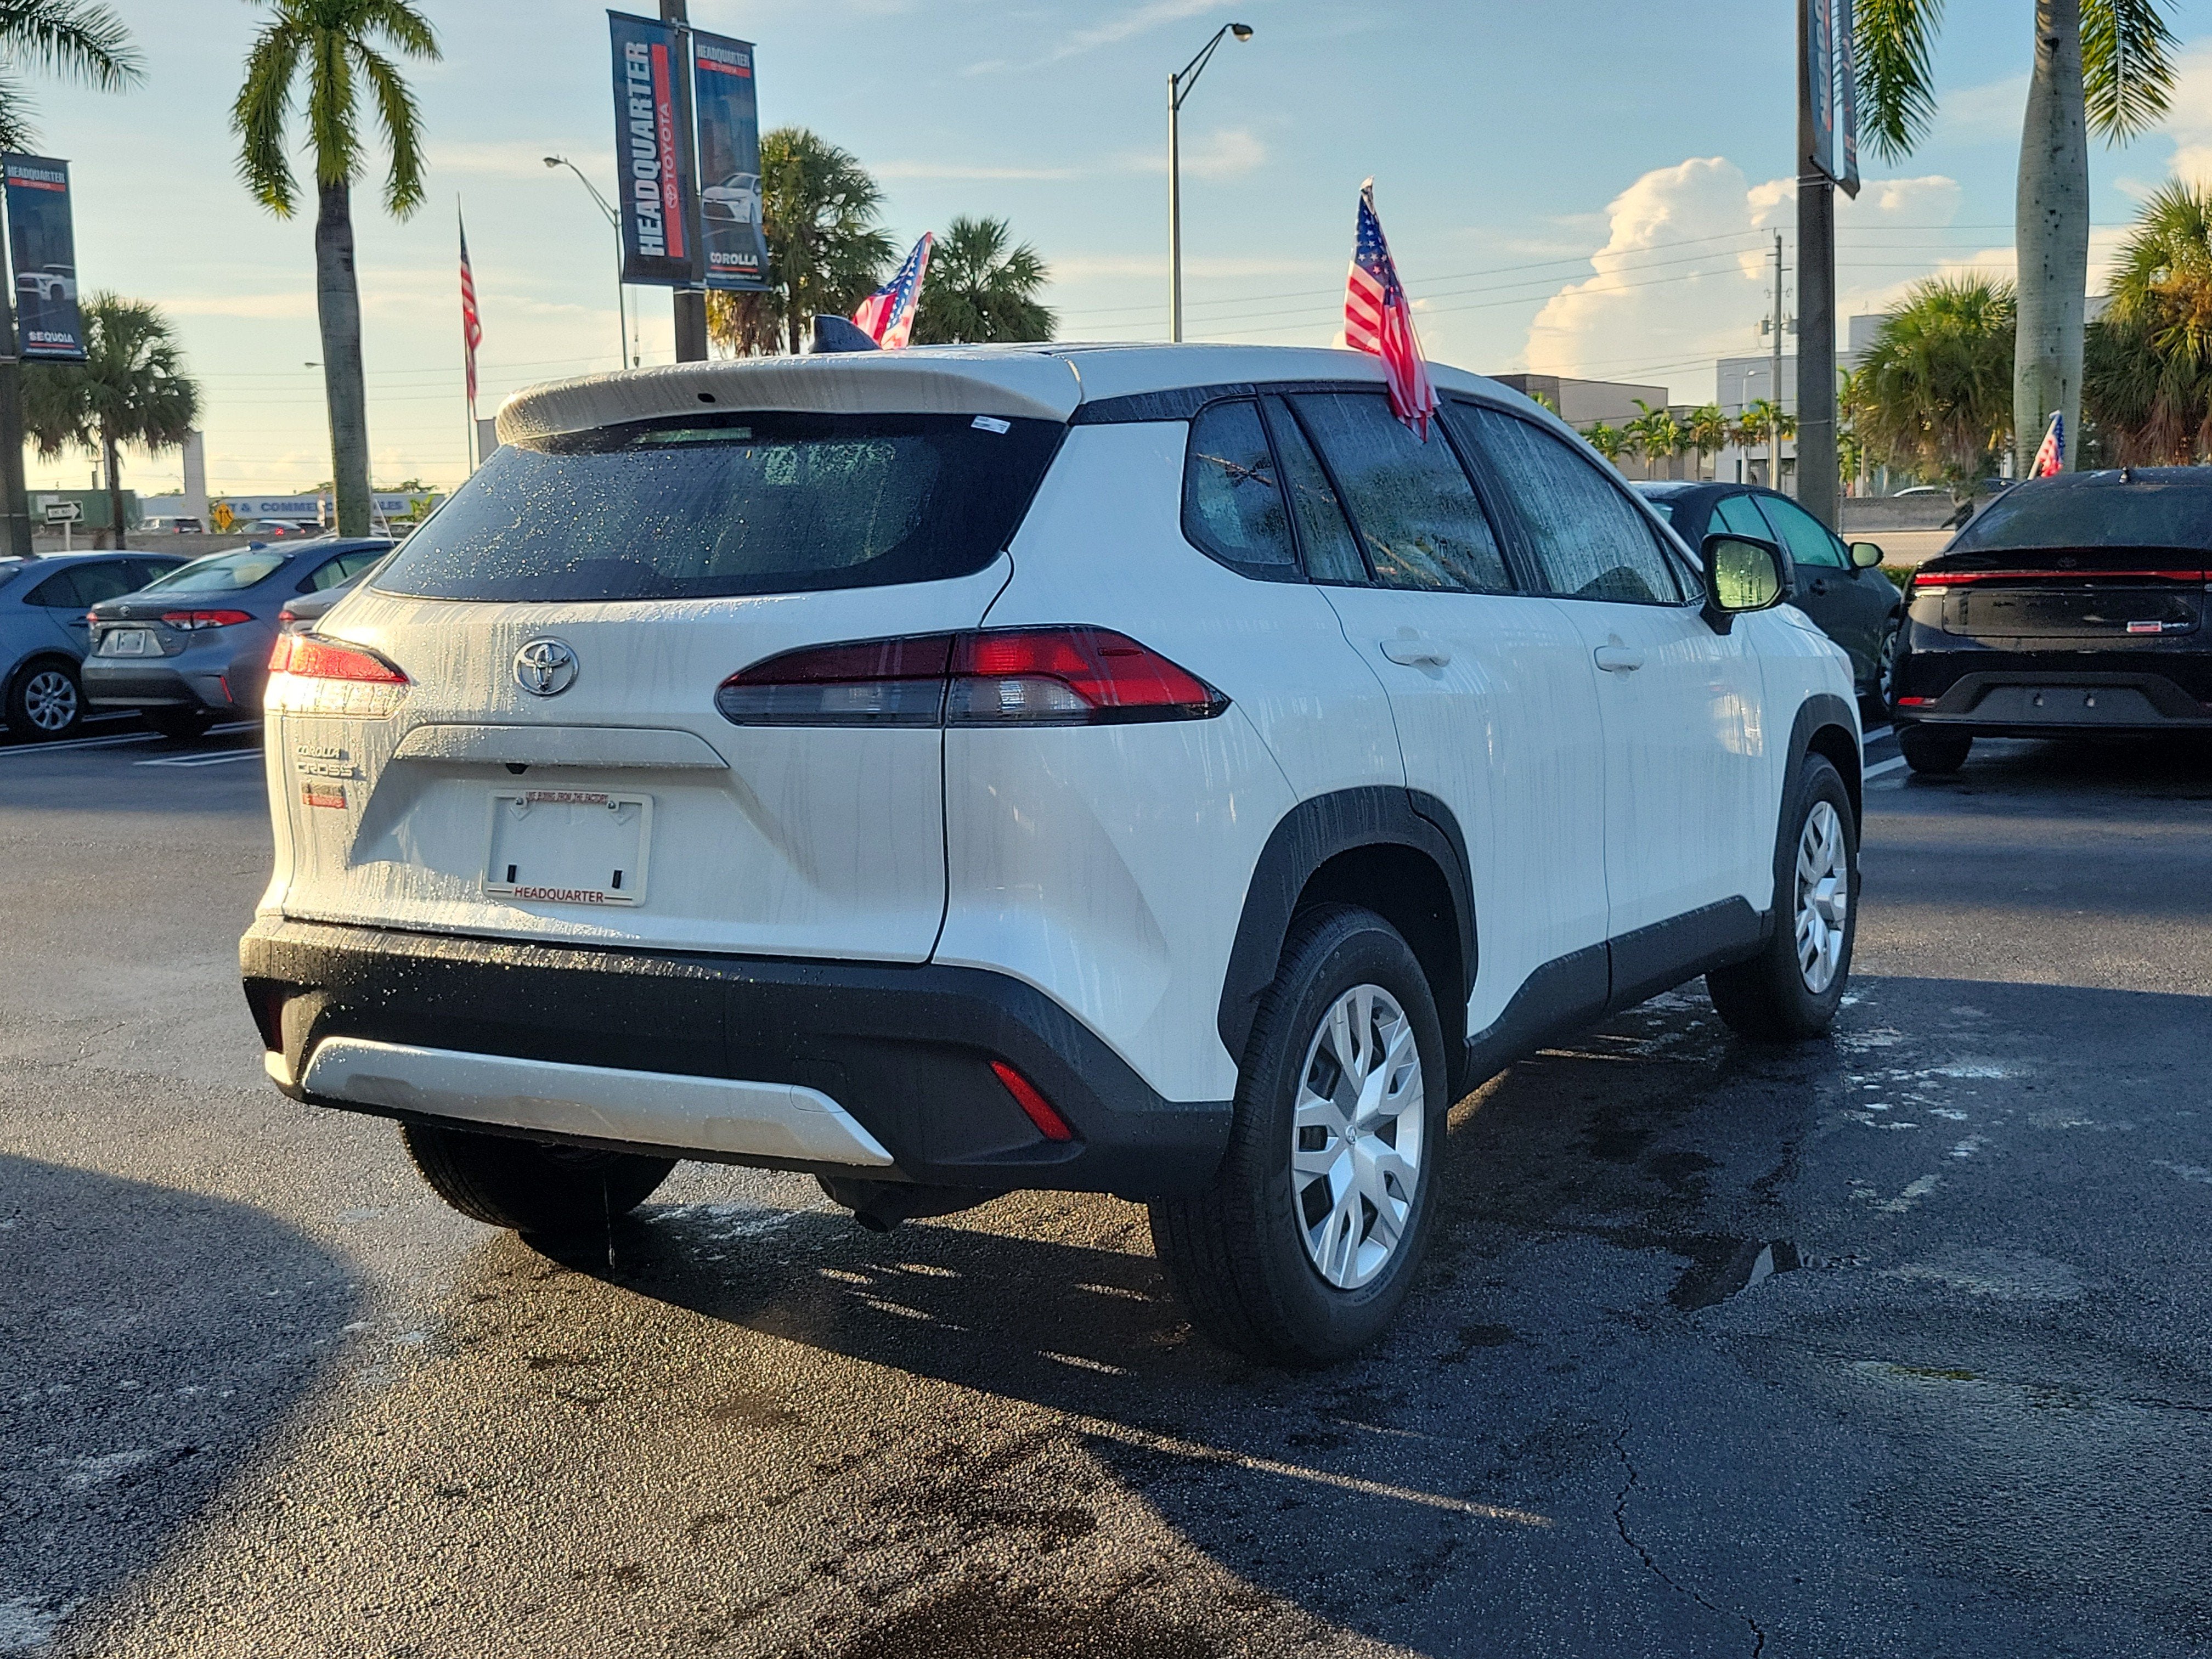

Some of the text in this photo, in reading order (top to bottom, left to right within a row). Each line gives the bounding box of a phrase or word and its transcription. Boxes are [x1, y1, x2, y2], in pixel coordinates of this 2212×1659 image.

[697, 44, 750, 67] HEADQUARTER
[625, 42, 665, 256] HEADQUARTER
[657, 103, 678, 181] TOYOTA
[7, 165, 65, 183] HEADQUARTER
[710, 252, 759, 266] COROLLA
[29, 331, 75, 343] SEQUOIA
[297, 744, 340, 758] COROLLA
[296, 761, 354, 777] CROSS
[514, 886, 605, 903] HEADQUARTER
